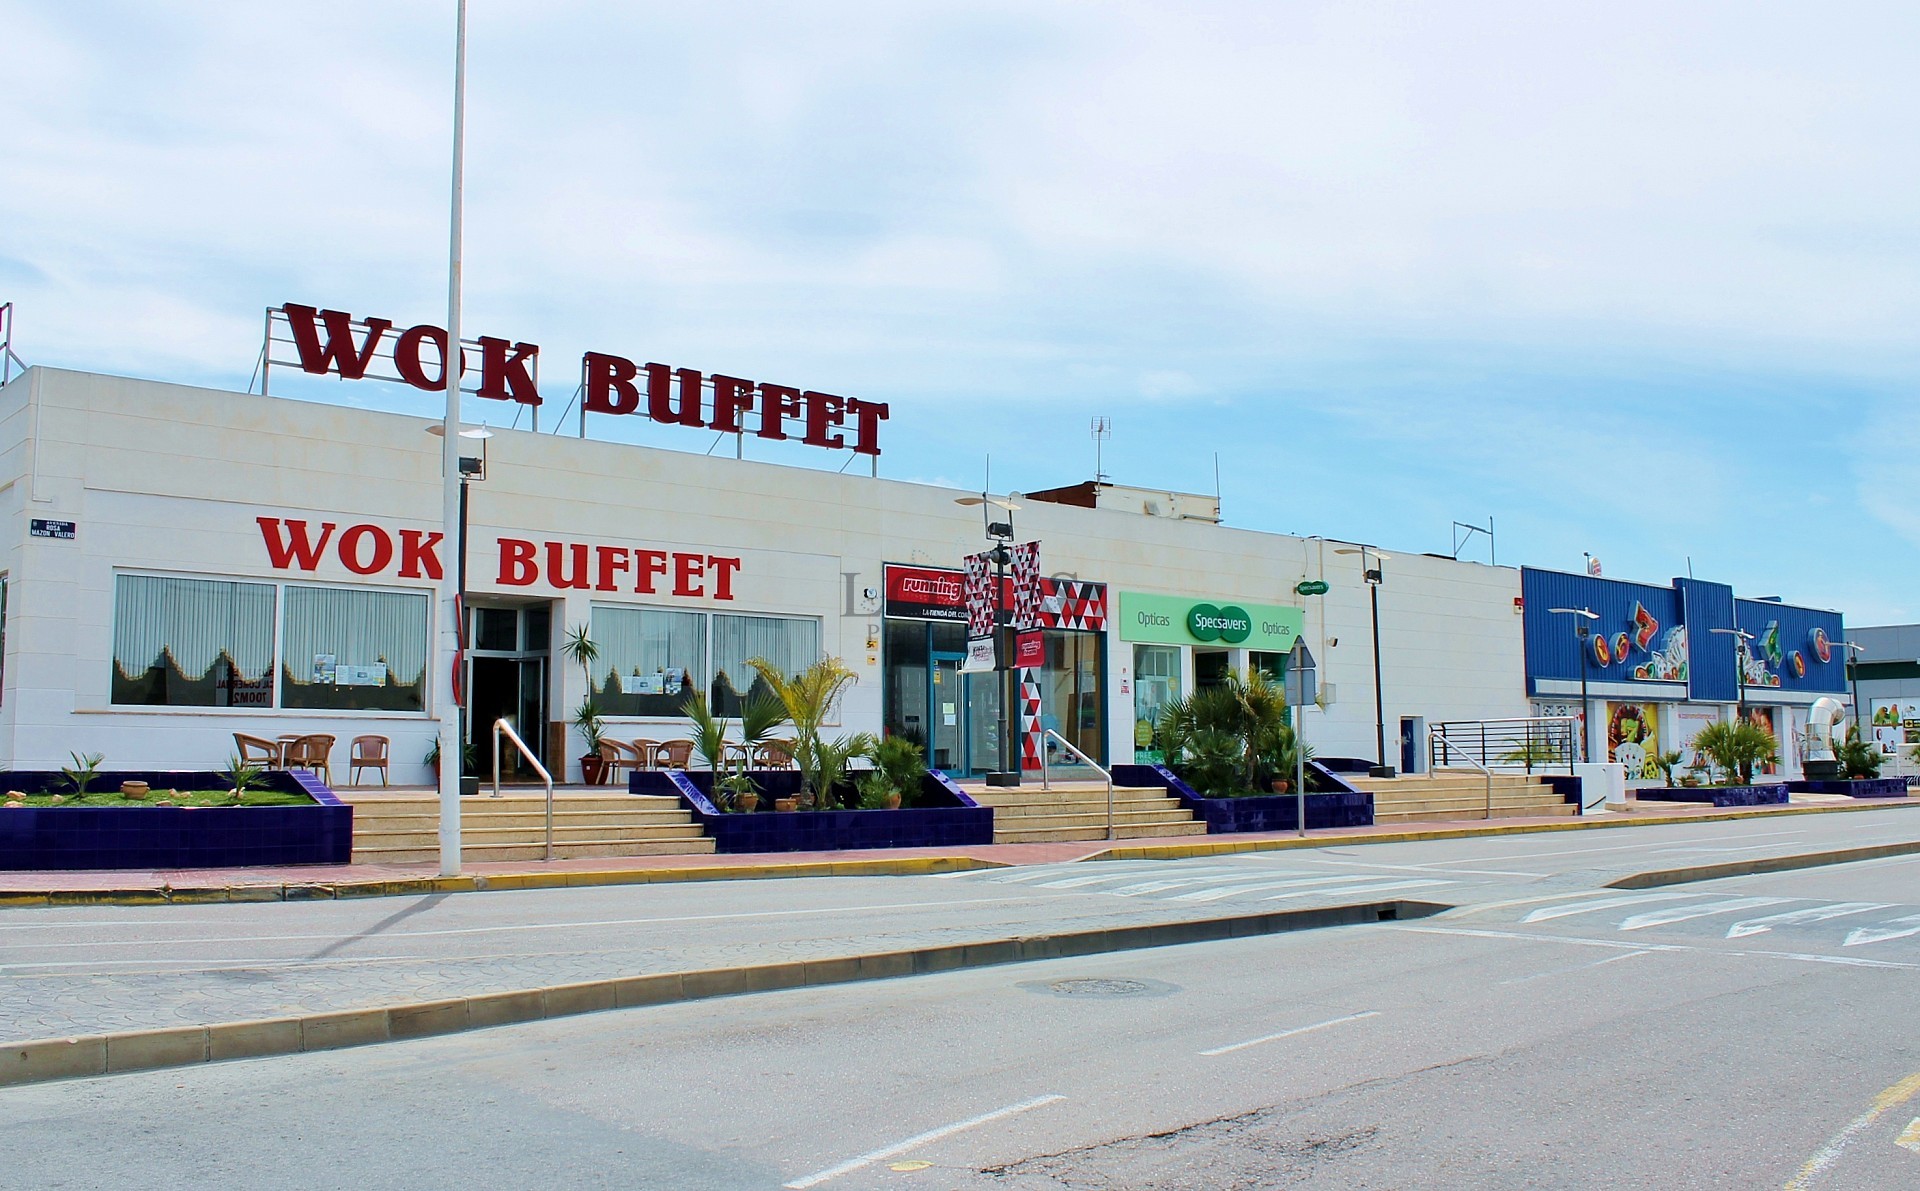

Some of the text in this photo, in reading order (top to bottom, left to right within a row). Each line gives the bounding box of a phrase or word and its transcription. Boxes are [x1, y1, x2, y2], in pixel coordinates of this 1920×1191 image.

[282, 302, 890, 456] WOK BUFFET
[257, 516, 742, 601] WOK BUFFET
[903, 577, 961, 600] running
[1138, 611, 1290, 636] Opticas Specsavers Opticas
